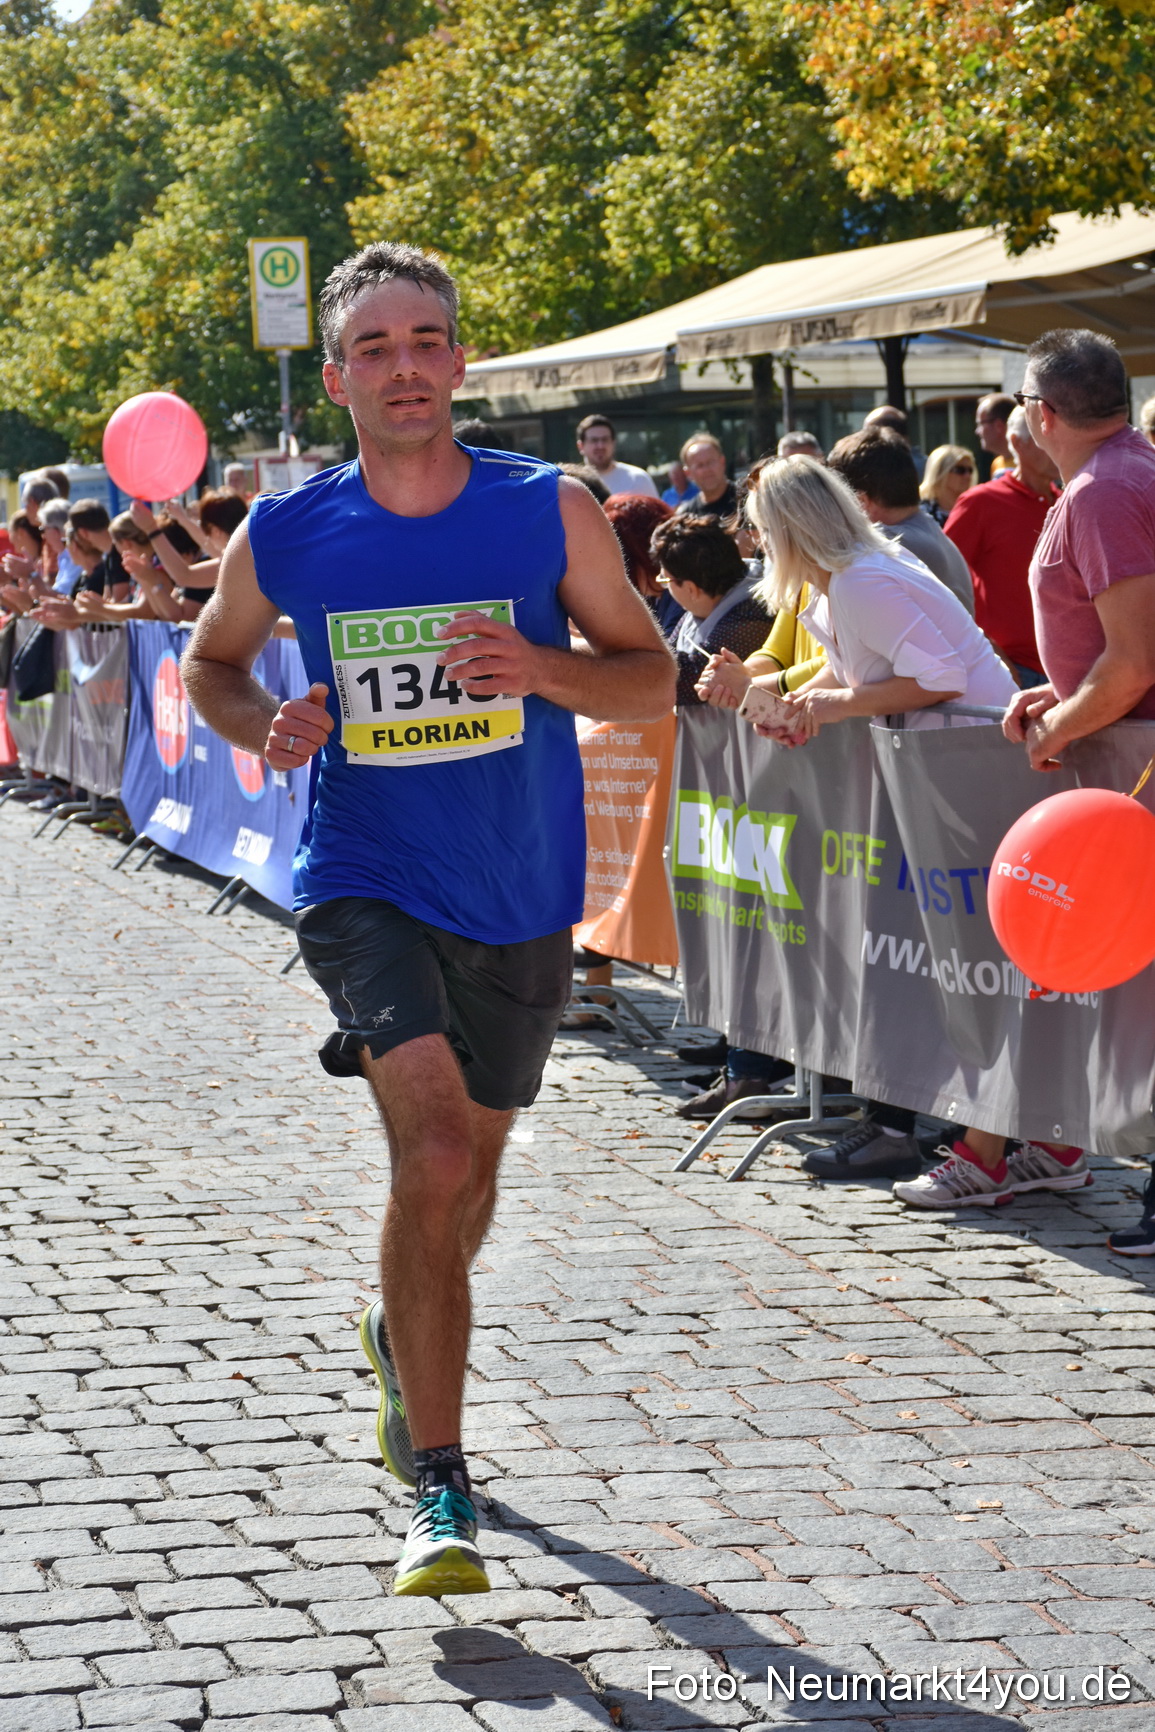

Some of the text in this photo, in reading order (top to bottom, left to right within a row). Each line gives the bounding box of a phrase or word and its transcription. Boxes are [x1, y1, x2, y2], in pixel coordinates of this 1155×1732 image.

[269, 256, 289, 278] H
[372, 719, 491, 748] FLORIAN
[609, 729, 643, 745] Partner
[592, 752, 608, 769] und
[608, 753, 658, 775] Umsetzung
[593, 780, 610, 793] was
[610, 777, 647, 794] Internet
[677, 801, 790, 896] BOCK
[1027, 888, 1071, 911] energie
